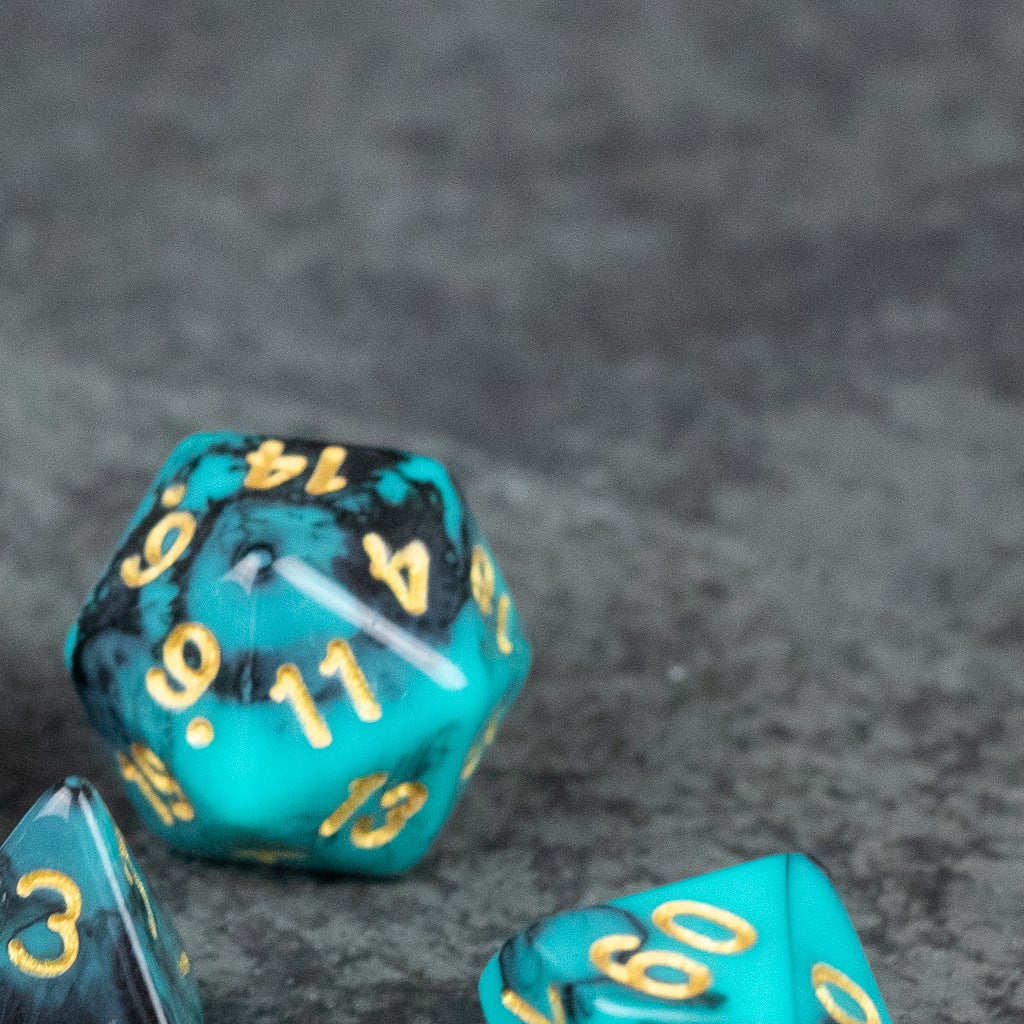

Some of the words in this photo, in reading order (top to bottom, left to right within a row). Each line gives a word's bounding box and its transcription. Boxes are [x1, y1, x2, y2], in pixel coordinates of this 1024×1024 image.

[362, 532, 430, 615] 4
[270, 639, 382, 749] 11
[319, 773, 429, 849] 13
[7, 868, 82, 978] 3
[589, 899, 757, 1000] 60
